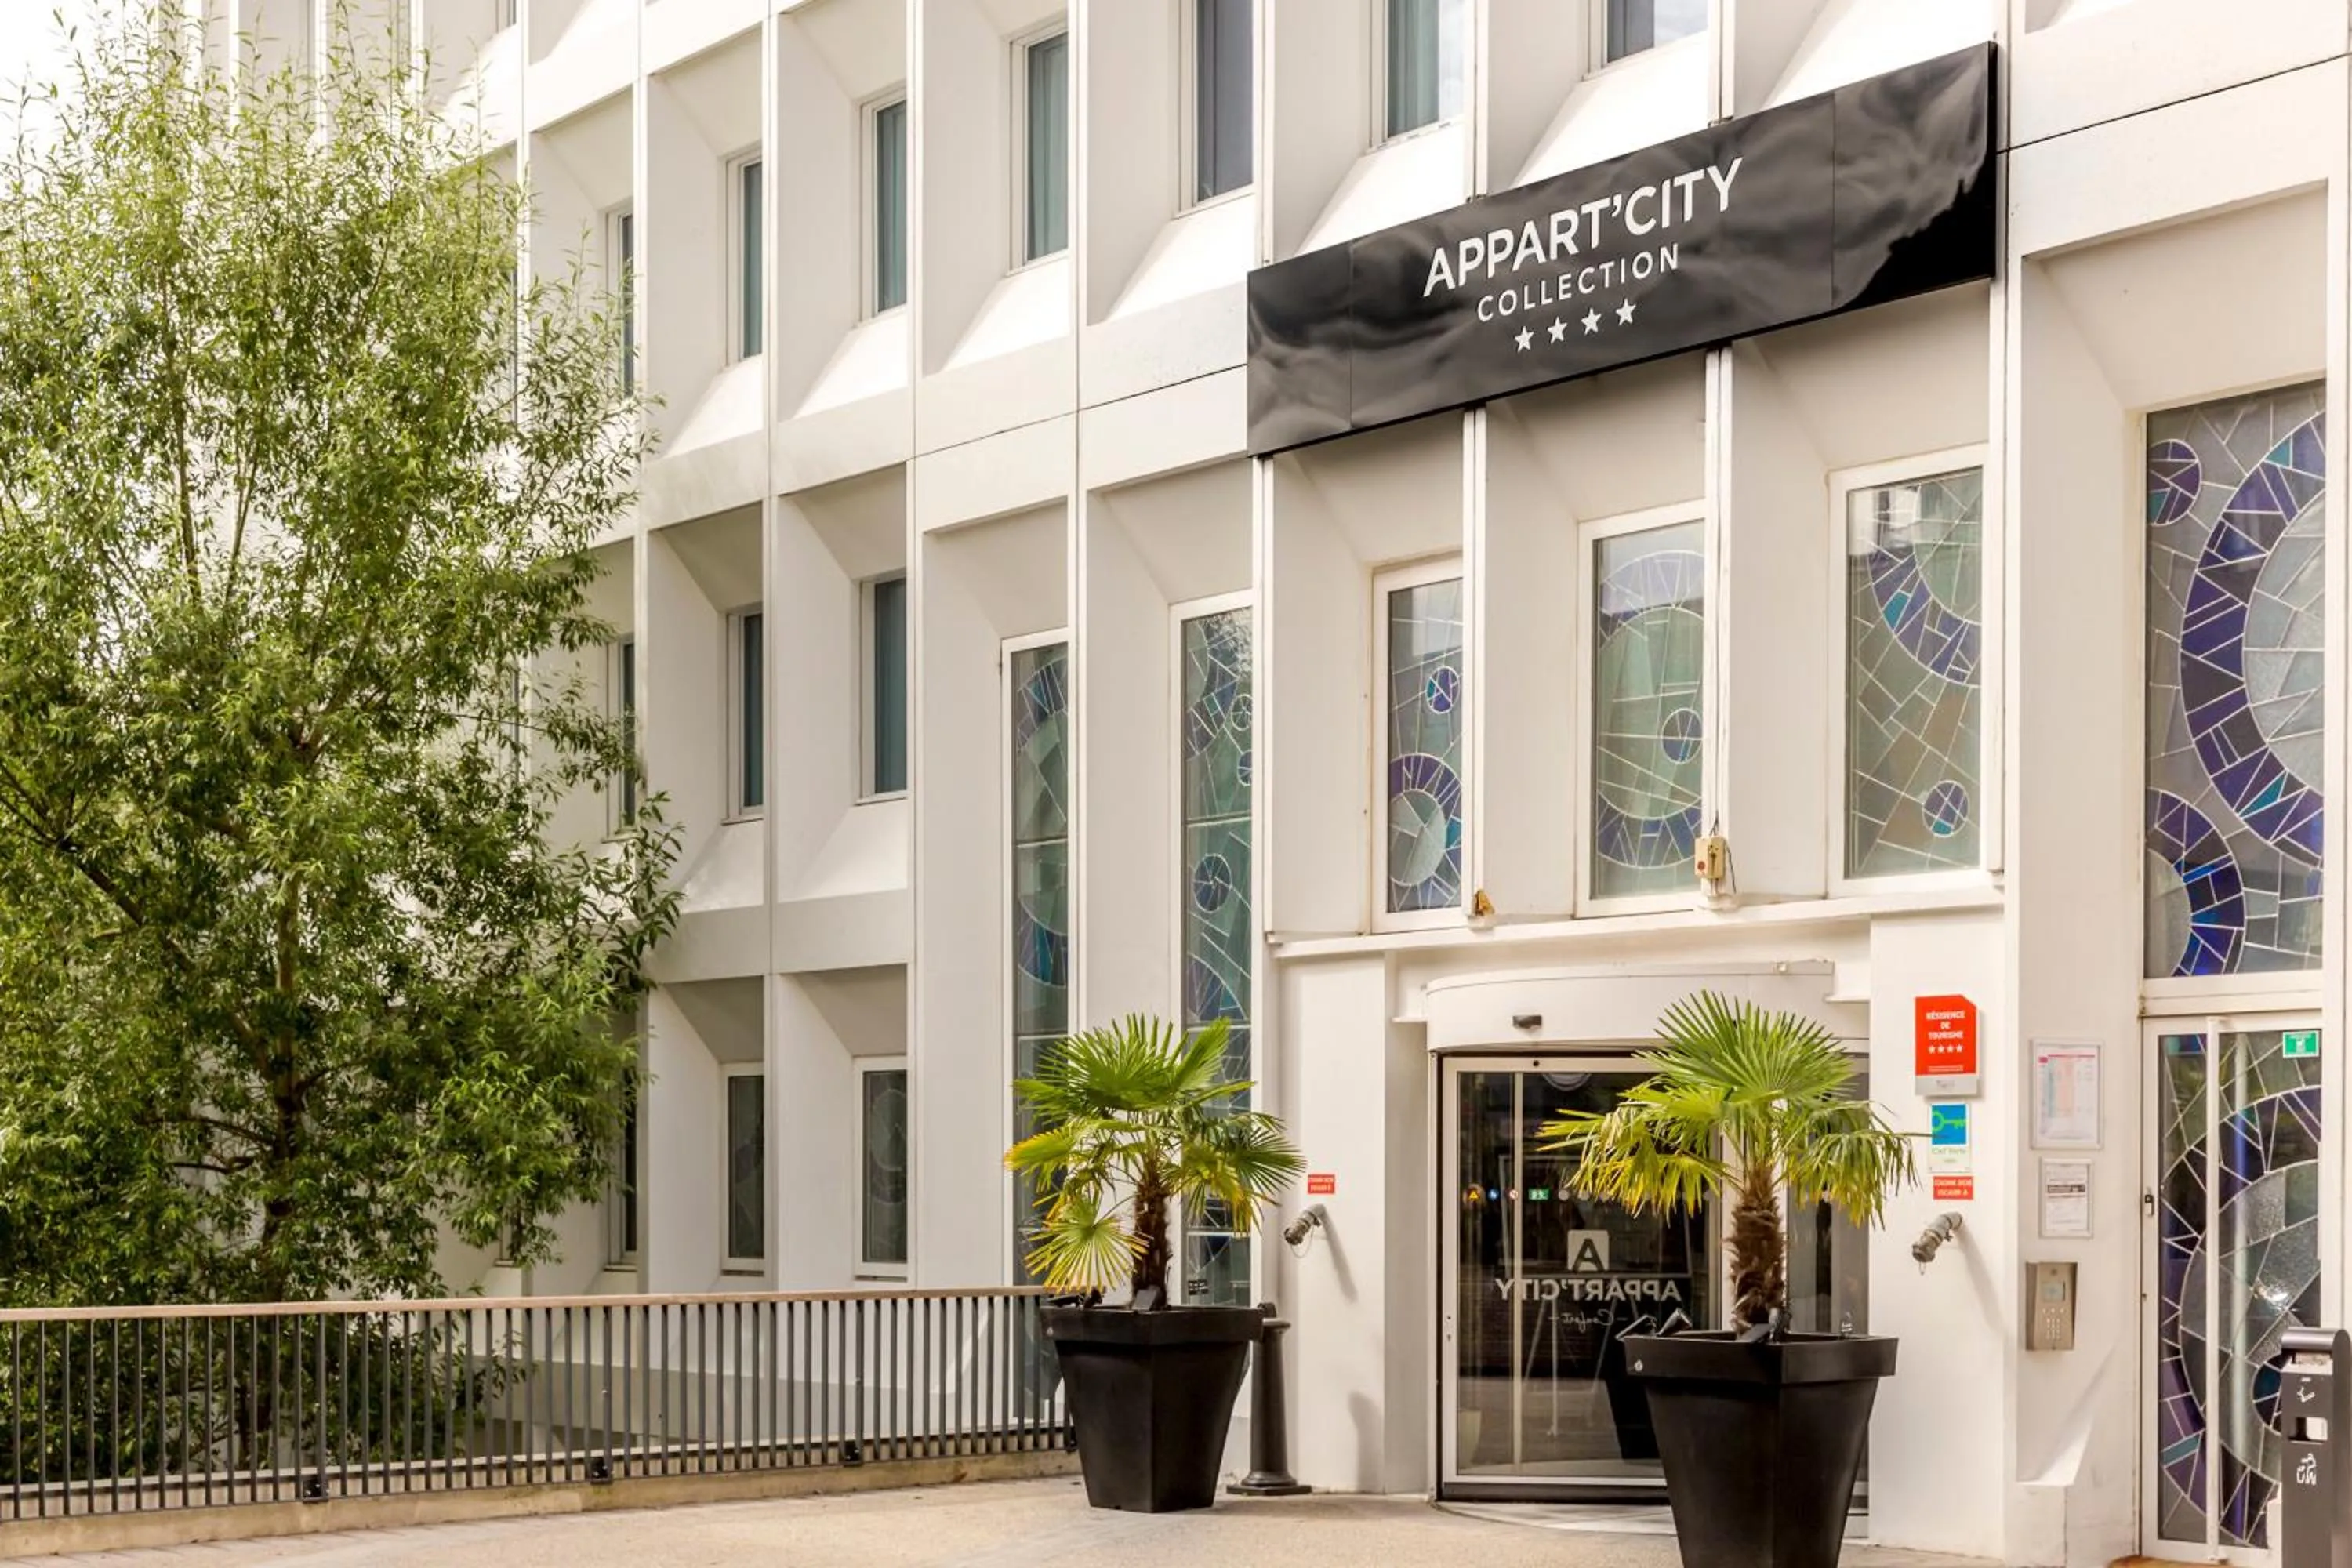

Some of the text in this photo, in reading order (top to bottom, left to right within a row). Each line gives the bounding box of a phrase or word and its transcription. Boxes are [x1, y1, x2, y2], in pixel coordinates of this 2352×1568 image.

[1423, 158, 1743, 297] APPART'CITY
[1477, 243, 1679, 322] COLLECTION
[1928, 1030, 1963, 1040] TOURISME
[1940, 1021, 1951, 1029] DE
